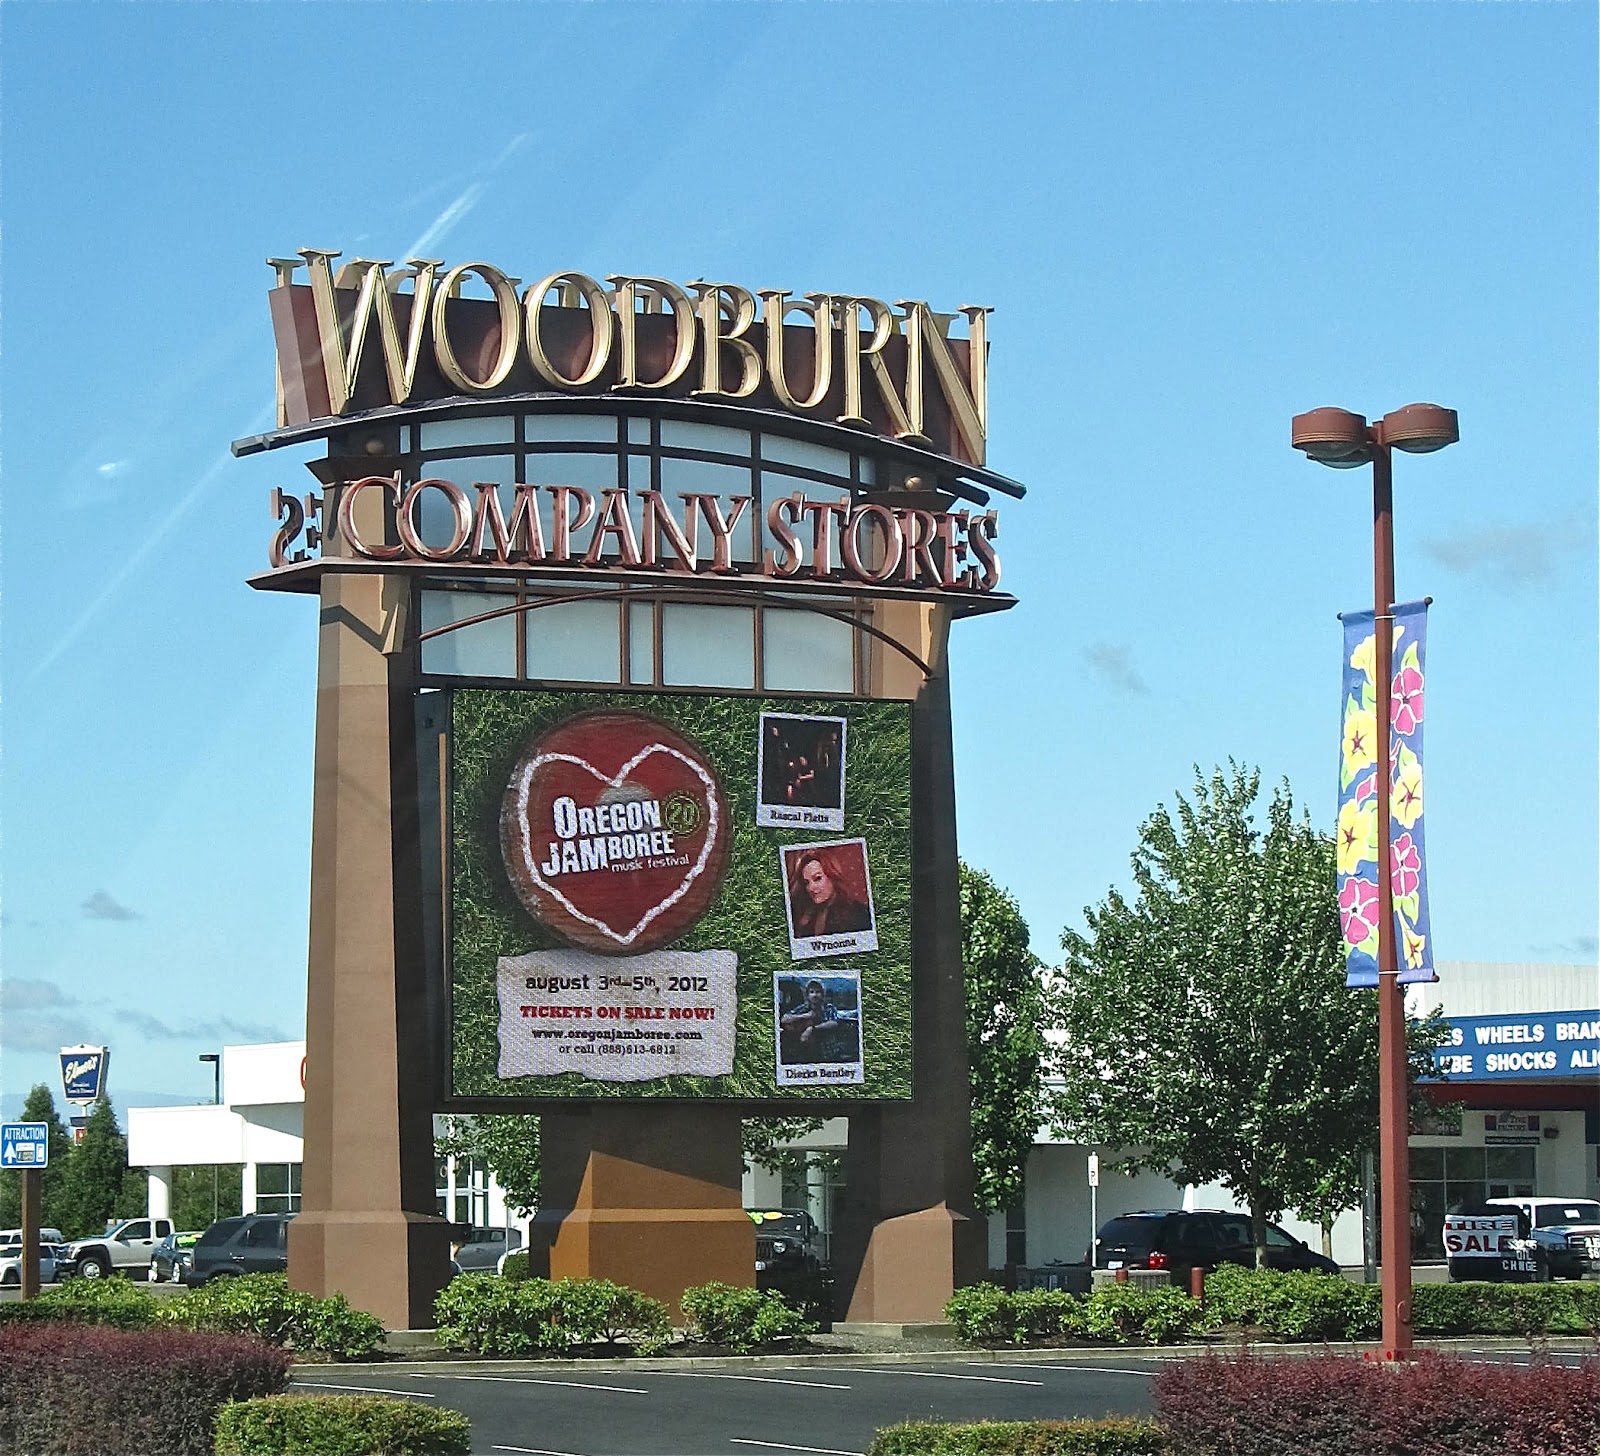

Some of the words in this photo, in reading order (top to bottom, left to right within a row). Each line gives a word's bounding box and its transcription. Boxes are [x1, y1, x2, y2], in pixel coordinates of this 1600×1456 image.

[297, 247, 994, 466] WOODBURN
[338, 470, 752, 576] COMPANY
[764, 491, 1001, 592] STORES
[553, 797, 662, 838] OREGON
[770, 809, 801, 821] Rascal
[541, 830, 676, 877] JAMBOREE
[612, 861, 643, 873] music
[648, 853, 690, 869] festival
[811, 939, 857, 952] Wynonna
[525, 975, 590, 993] august
[668, 977, 708, 991] 2012
[520, 1006, 592, 1018] TICKETS
[597, 1006, 621, 1018] ON
[624, 1007, 665, 1019] SALE
[668, 1007, 715, 1020] NOW!
[532, 1029, 702, 1041] www.oregonjamboree.com
[1475, 1024, 1545, 1044] WHEELS
[559, 1045, 571, 1054] or
[574, 1044, 594, 1054] call
[1431, 1055, 1473, 1073] UBE
[1485, 1051, 1557, 1073] SHOCKS
[1570, 1049, 1600, 1068] ALI
[4, 1127, 45, 1140] ATTRACTION
[1446, 1219, 1514, 1231] TIRE
[1446, 1234, 1514, 1253] SALE
